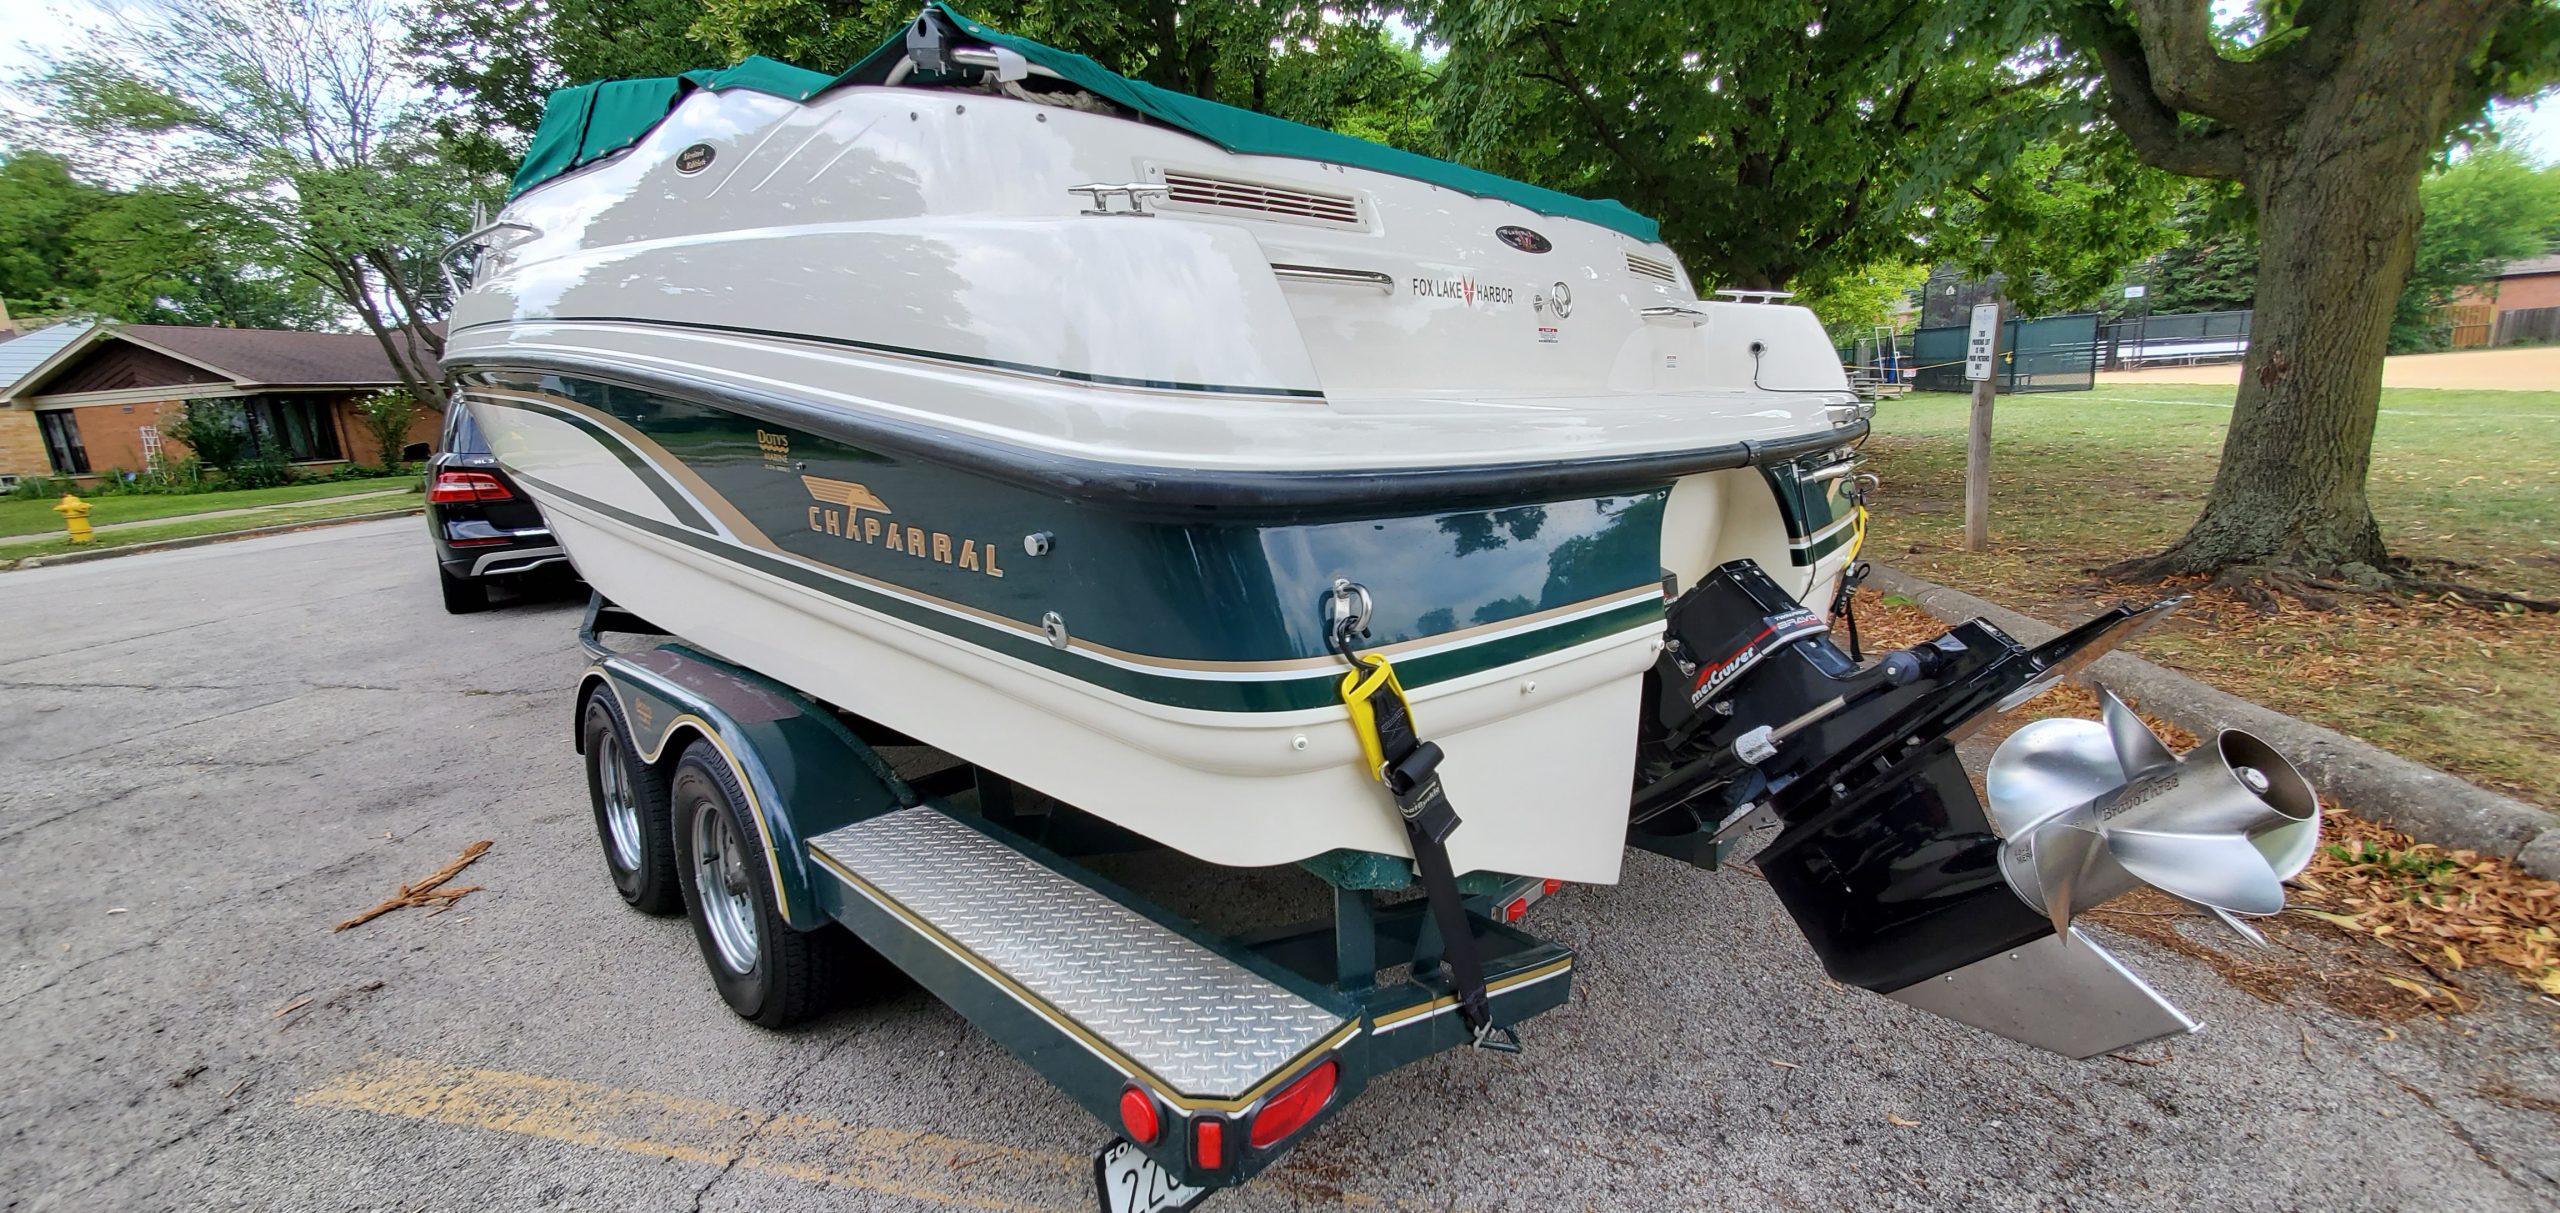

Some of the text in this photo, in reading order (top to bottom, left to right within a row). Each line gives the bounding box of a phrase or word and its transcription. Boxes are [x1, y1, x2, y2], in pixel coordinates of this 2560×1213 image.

[1412, 278, 1514, 305] FOX LAKE HARBOR
[808, 505, 1004, 578] CHAPARRAL
[1776, 614, 1818, 630] BRAVO
